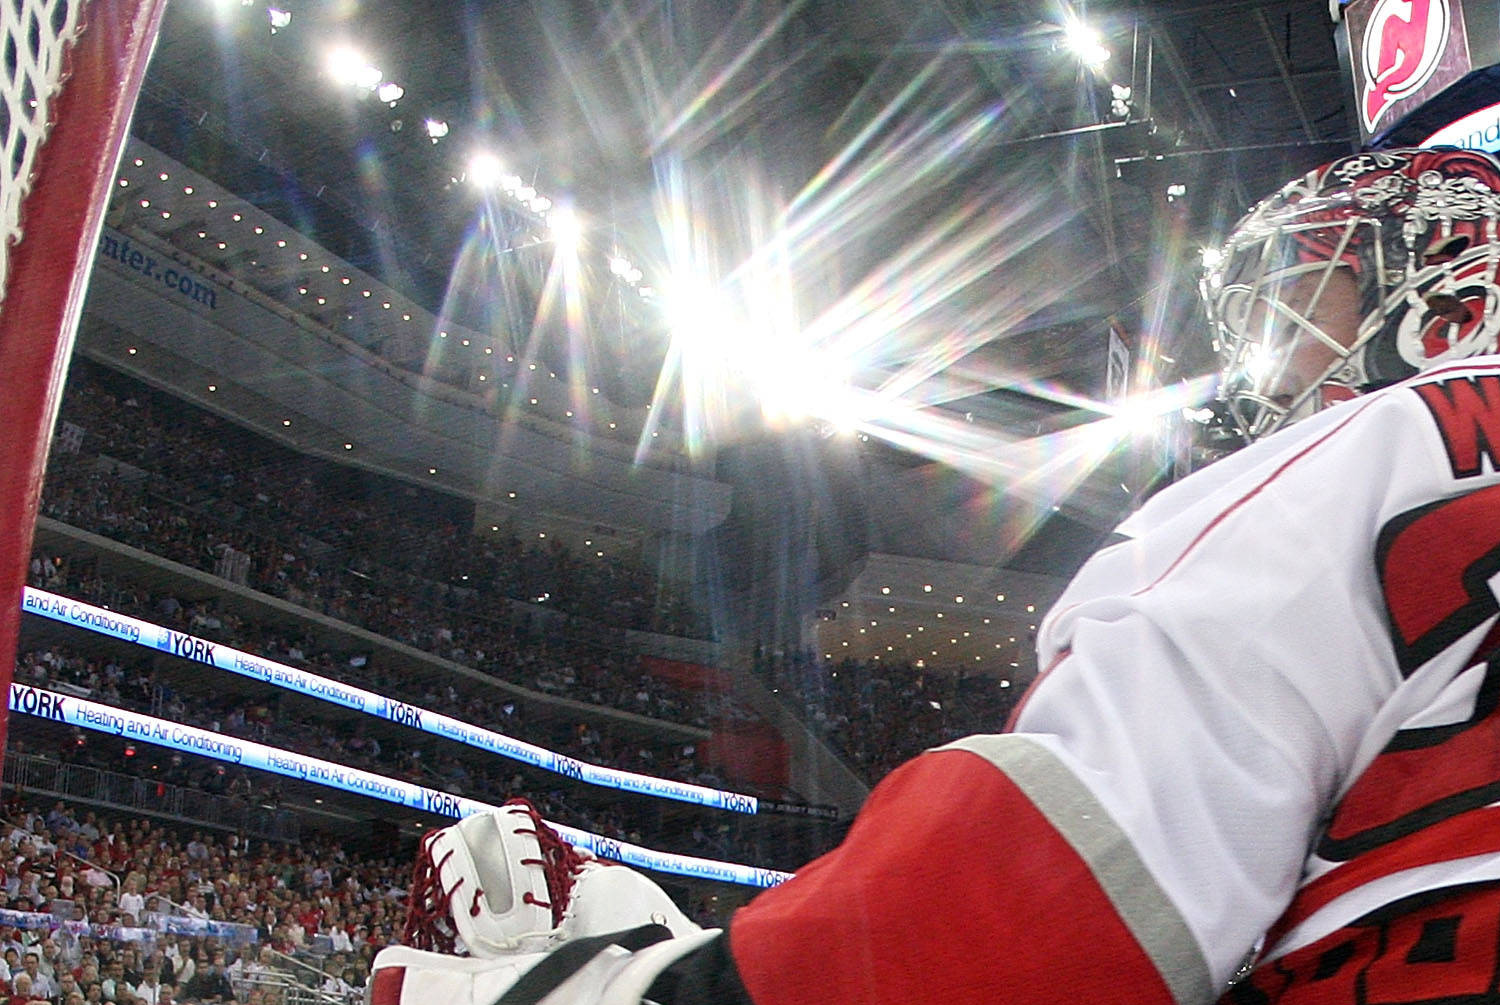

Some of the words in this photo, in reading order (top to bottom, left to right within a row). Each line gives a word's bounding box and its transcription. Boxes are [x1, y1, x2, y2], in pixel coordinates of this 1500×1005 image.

[101, 235, 217, 309] nter.com
[12, 686, 66, 722] YORK
[76, 704, 125, 735] Heating
[127, 720, 150, 736] and
[152, 723, 169, 739] Air
[172, 728, 242, 764] Conditioning
[267, 751, 307, 779] Heating
[310, 764, 329, 781] and
[332, 769, 345, 784] Air
[349, 773, 406, 805] Conditioning
[426, 791, 461, 818] YORK
[594, 838, 622, 860] YORK
[26, 593, 49, 612] and
[51, 600, 67, 615] Air
[71, 605, 140, 642] Conditioning
[174, 633, 215, 665] YORK
[235, 655, 272, 683] Heating
[275, 669, 293, 684] and
[295, 675, 307, 689] Air
[310, 678, 365, 711] Conditioning
[389, 701, 422, 729] YORK
[556, 754, 583, 779] YORK
[724, 793, 753, 814] YORK
